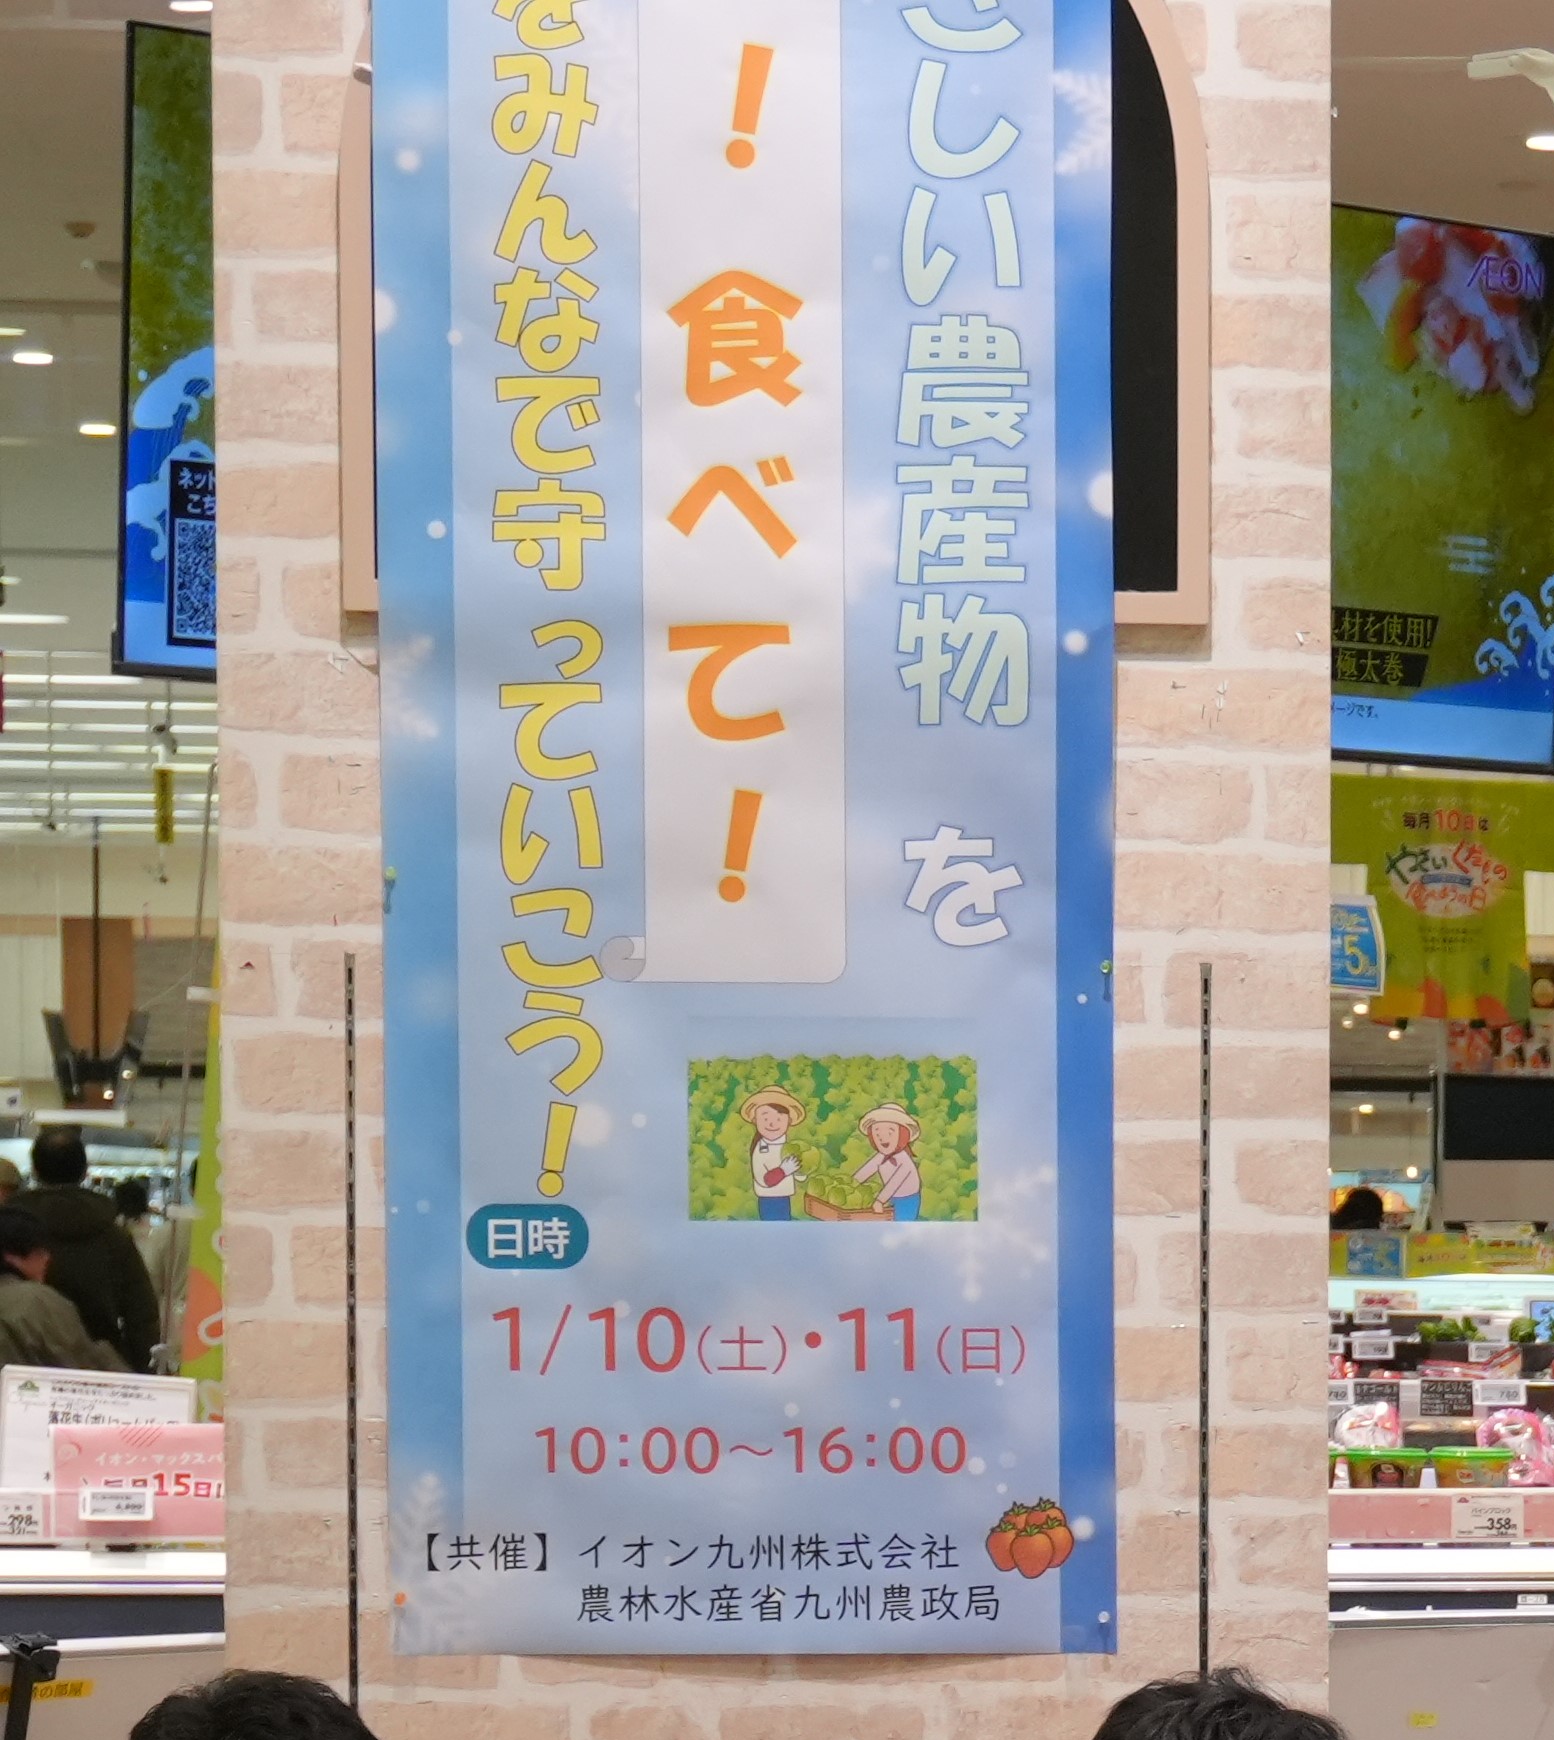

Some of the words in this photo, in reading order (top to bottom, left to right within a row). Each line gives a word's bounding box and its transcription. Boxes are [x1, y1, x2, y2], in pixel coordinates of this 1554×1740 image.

[484, 1216, 572, 1261] 日時
[577, 1532, 961, 1573] イオン九州株式会社
[576, 1582, 1001, 1624] 農林水産省九州農政局
